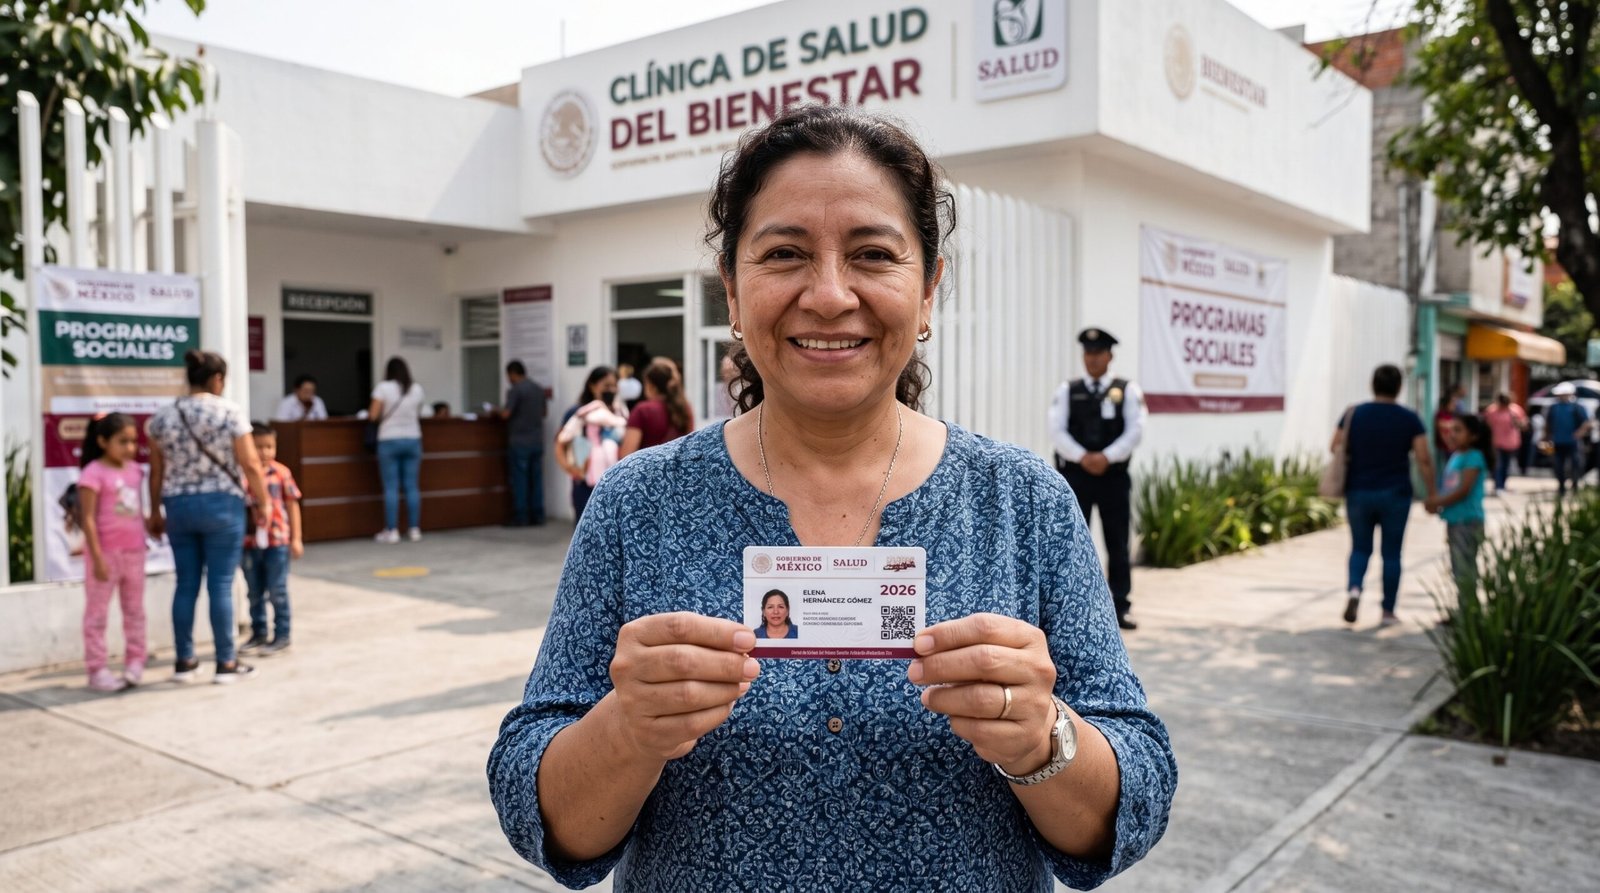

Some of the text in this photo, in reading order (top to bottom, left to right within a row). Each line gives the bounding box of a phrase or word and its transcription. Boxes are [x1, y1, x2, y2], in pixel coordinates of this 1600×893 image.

[609, 8, 928, 105] CLÍNICA DE SALUD
[978, 47, 1059, 81] SALUD
[610, 58, 921, 150] DEL BIENESTAR
[55, 320, 189, 343] PROGRAMAS
[1171, 300, 1266, 338] PROGRAMAS
[72, 340, 175, 360] SOCIALES
[1182, 336, 1255, 367] SOCIALES
[776, 562, 822, 571] MÉXICO
[833, 559, 868, 567] SALUD
[880, 584, 917, 596] 2026
